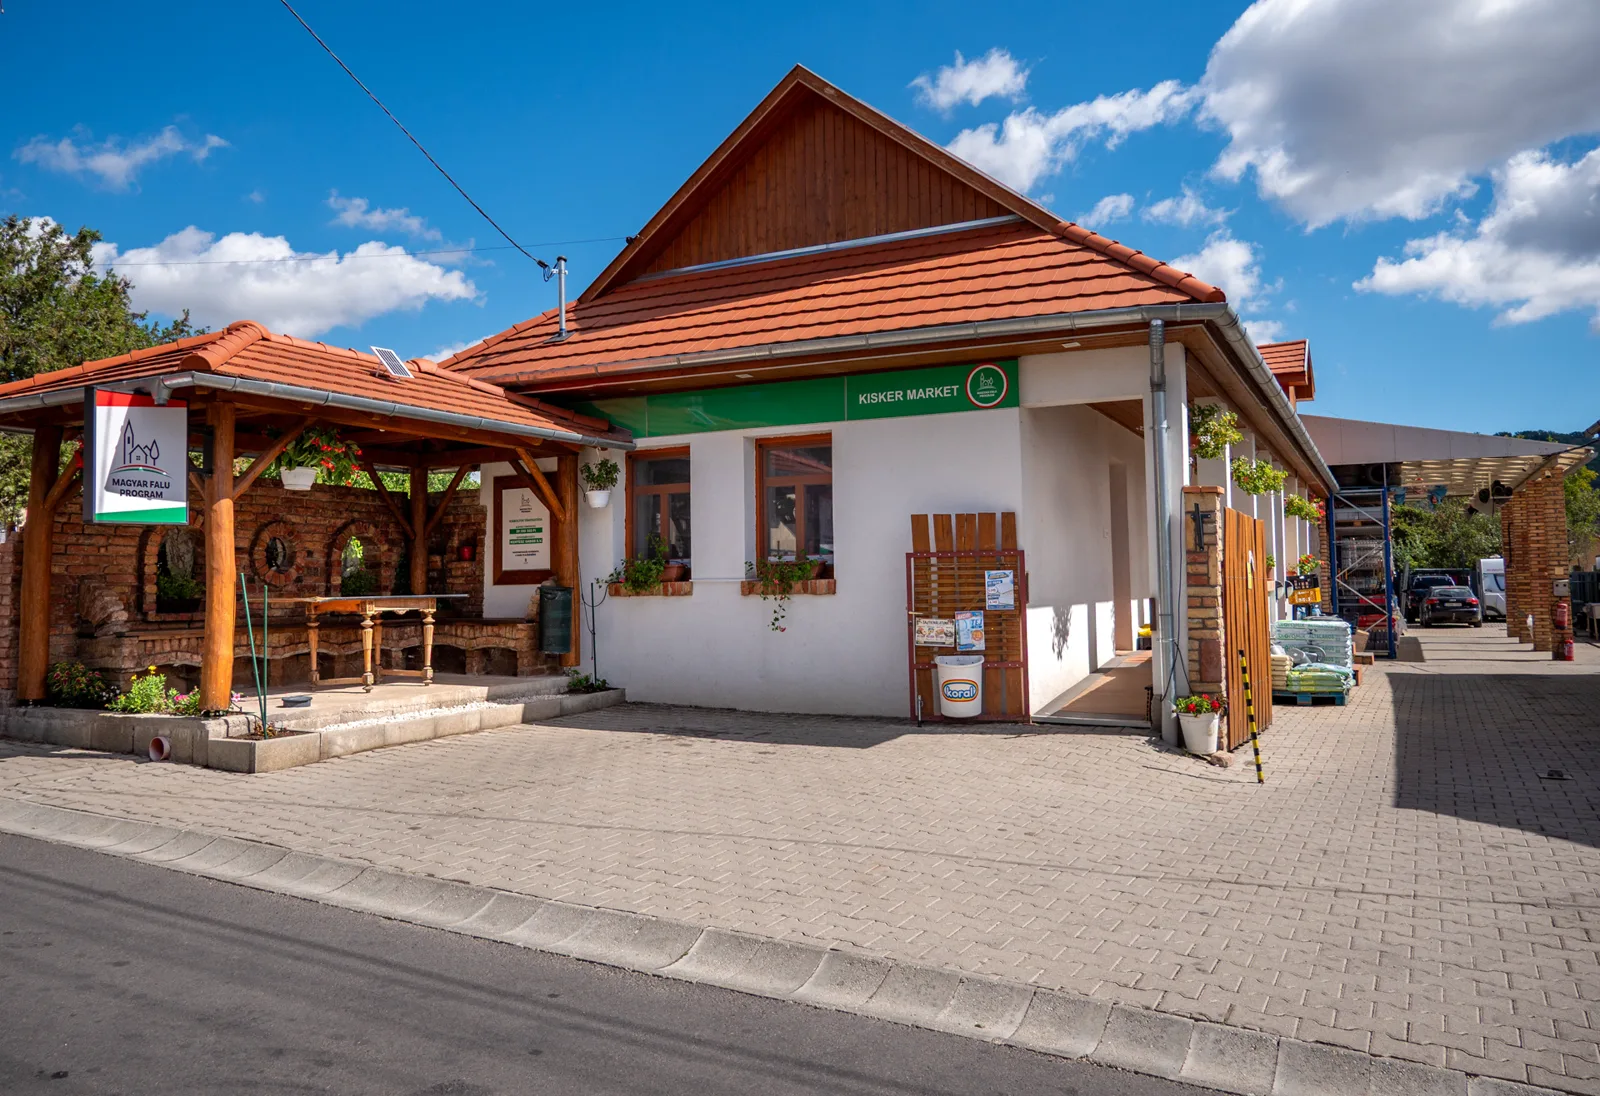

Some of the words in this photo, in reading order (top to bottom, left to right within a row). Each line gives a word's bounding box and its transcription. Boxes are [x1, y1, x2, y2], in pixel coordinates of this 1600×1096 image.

[859, 390, 903, 404] KISKER
[907, 385, 959, 400] MARKET
[112, 478, 148, 488] MAGYAR
[150, 480, 170, 489] FALU
[120, 489, 163, 498] PROGRAM
[971, 618, 982, 626] TEJ
[945, 685, 973, 698] koral
